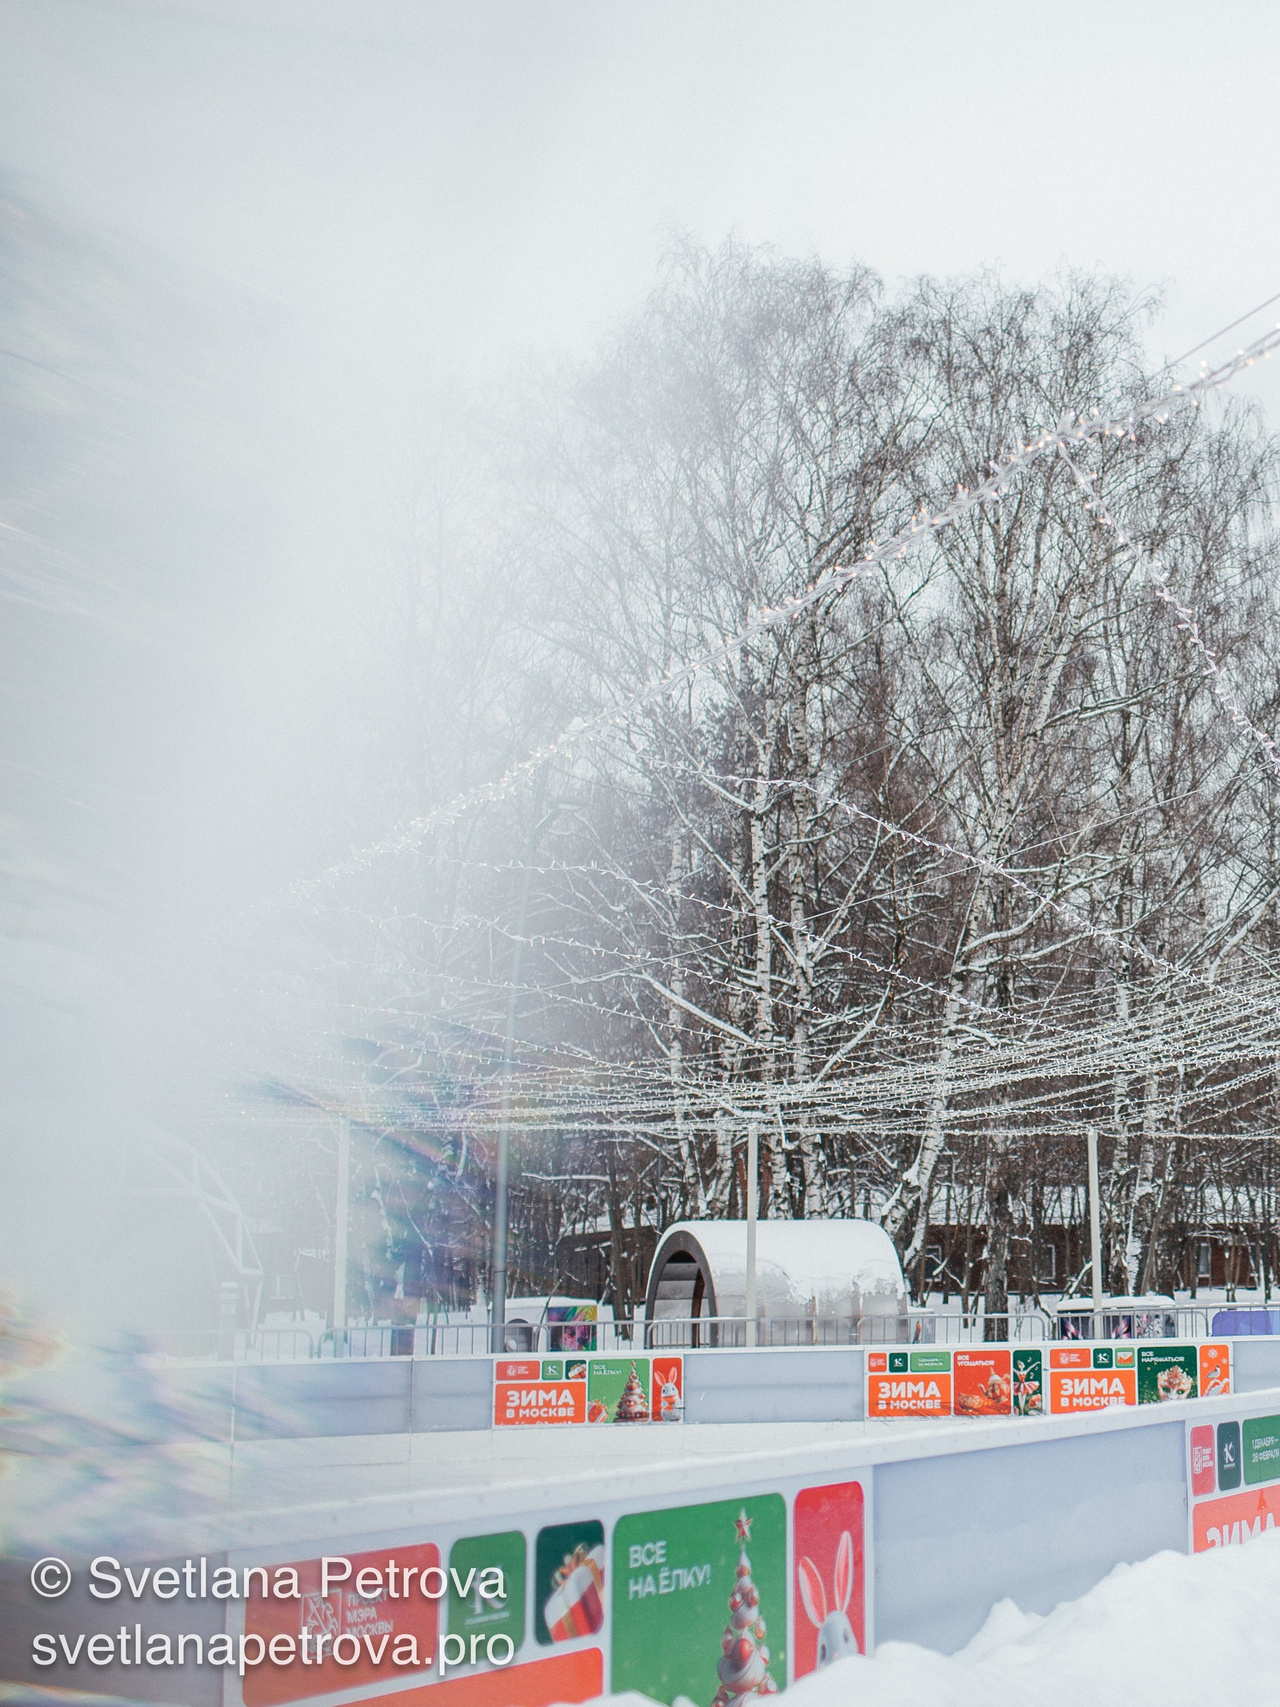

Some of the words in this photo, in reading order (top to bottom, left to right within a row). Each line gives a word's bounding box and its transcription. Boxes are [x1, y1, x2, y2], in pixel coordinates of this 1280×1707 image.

[878, 1381, 942, 1399] ЗИМА
[1060, 1377, 1126, 1396] ЗИМА
[506, 1389, 575, 1407] ЗИМА
[878, 1400, 887, 1410] В
[890, 1399, 942, 1410] МОСКВЕ
[1060, 1397, 1070, 1407] В
[1073, 1396, 1126, 1407] МОСКВЕ
[506, 1408, 515, 1418] В
[519, 1407, 575, 1418] МОСКВЕ
[629, 1540, 667, 1569] ВСЕ
[629, 1575, 657, 1600] НА
[659, 1564, 712, 1595] ЁЛКУ!
[346, 1606, 378, 1624] МЭРА
